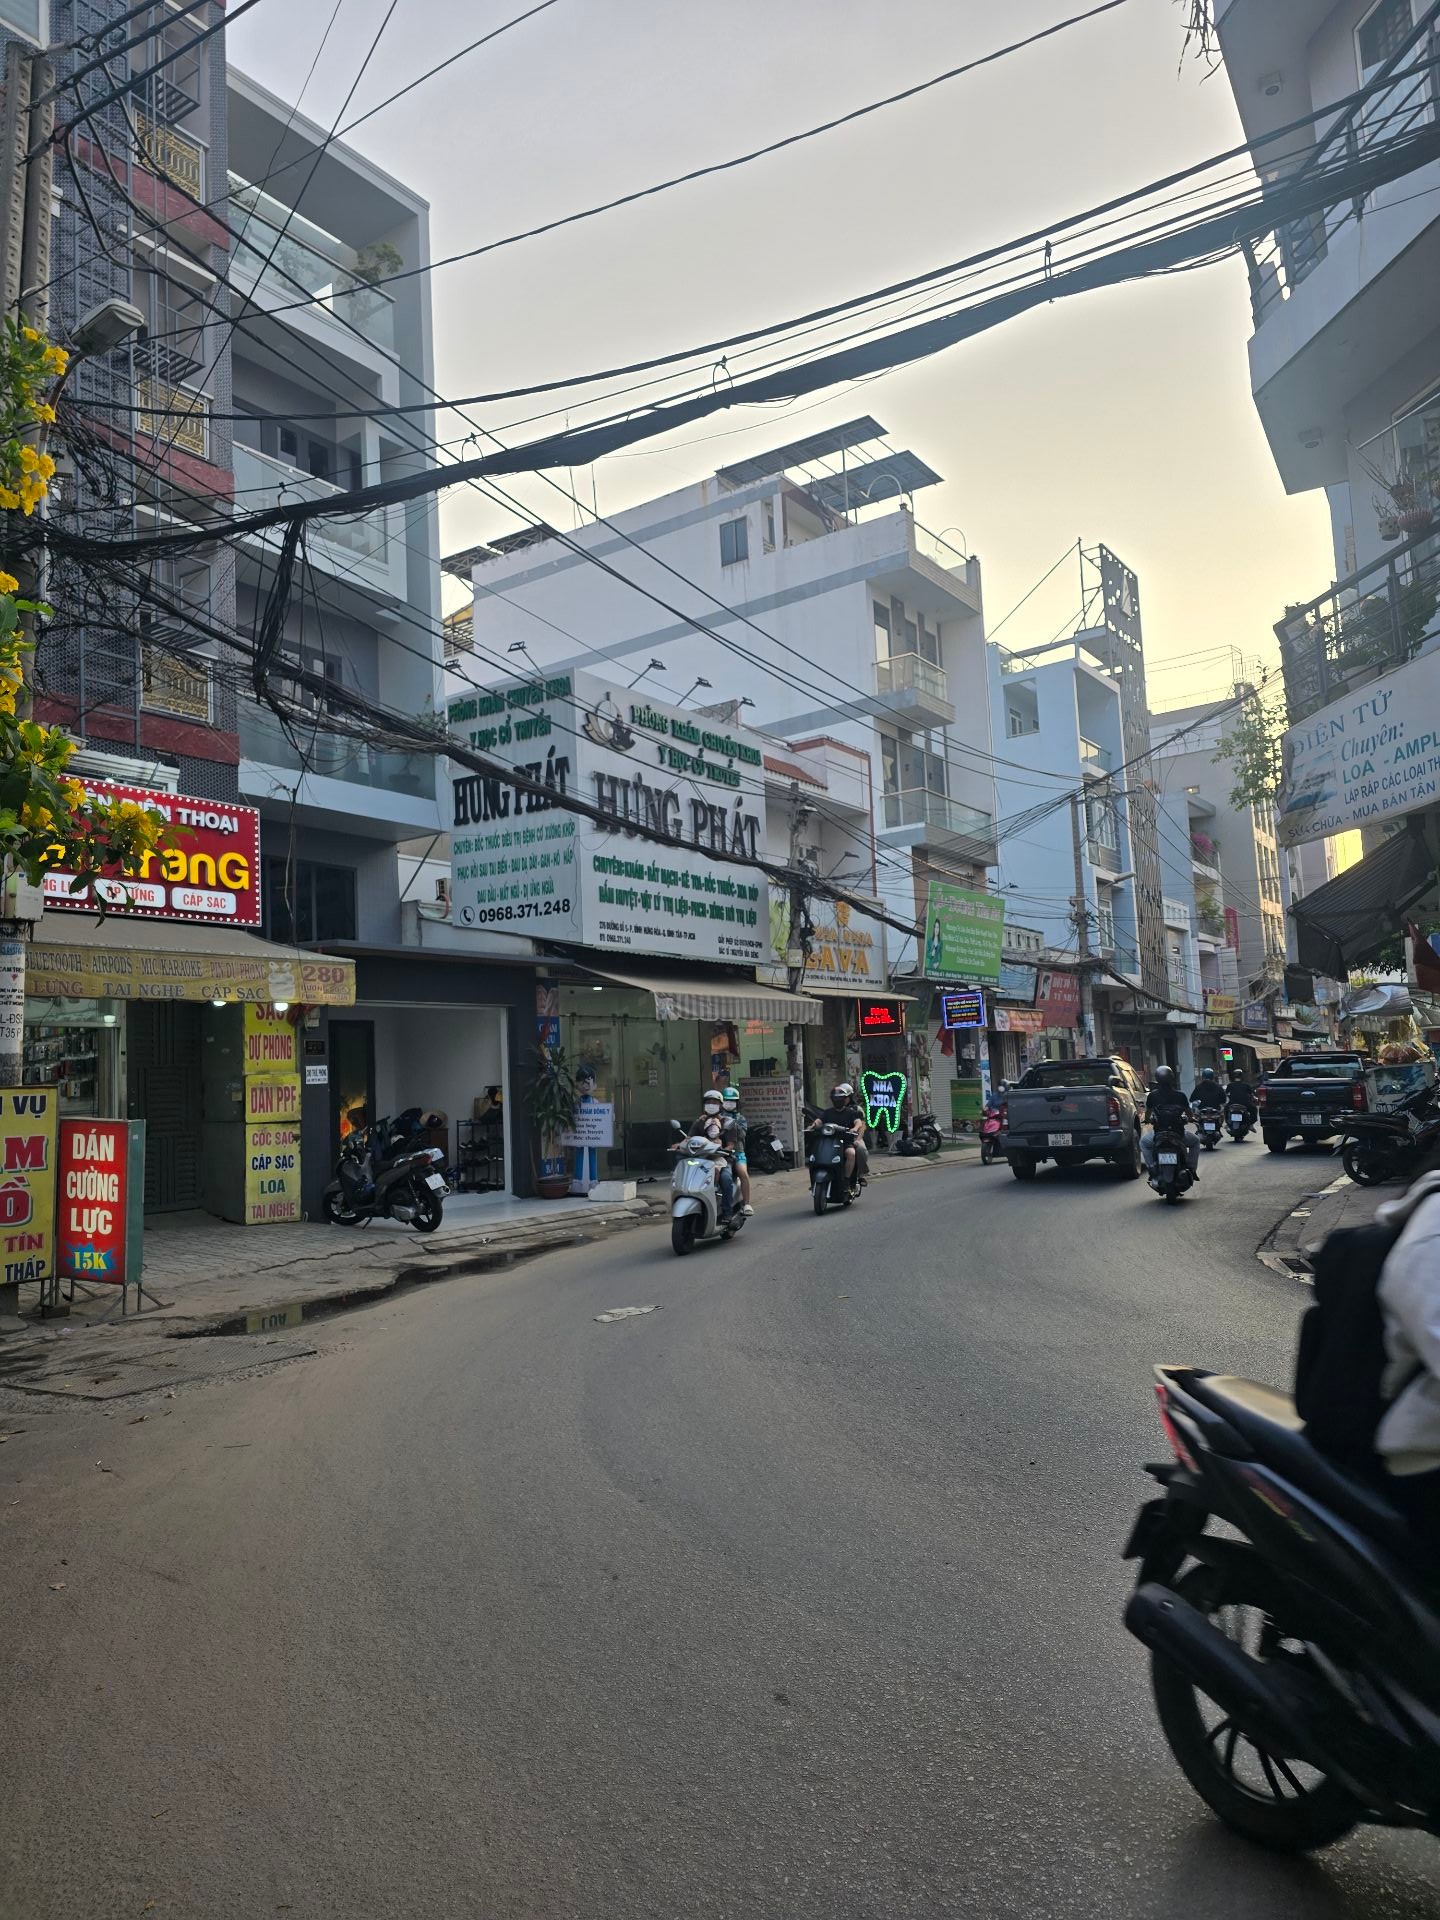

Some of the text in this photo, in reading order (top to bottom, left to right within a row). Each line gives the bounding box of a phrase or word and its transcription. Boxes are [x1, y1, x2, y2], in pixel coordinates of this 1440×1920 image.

[1353, 690, 1393, 724] TỬ
[631, 705, 762, 766] PHÒNG KHÁM CHUYÊN KHOA
[1342, 722, 1404, 762] Chuyên:
[1343, 760, 1375, 784] LOA
[1382, 771, 1400, 790] CÁC
[1403, 764, 1426, 782] LOẠI
[1312, 815, 1343, 832] CHỮA
[1353, 803, 1379, 821] MUA
[1382, 791, 1408, 810] BÁN
[1410, 781, 1436, 799] TẬN
[177, 807, 238, 835] THOẠI
[689, 796, 761, 861] PHÁT
[206, 896, 226, 911] SẠC
[479, 898, 570, 923] 0968.371.248
[93, 955, 133, 974] AIRPODS
[141, 957, 156, 976] MIC
[160, 958, 203, 978] KARAOKE
[210, 961, 224, 978] PIN
[302, 965, 345, 983] 280
[33, 978, 83, 995] LƯNG
[103, 983, 131, 996] TAI
[139, 984, 184, 997] NGHE
[249, 1033, 261, 1066] DỰ
[264, 1028, 291, 1060] PHÒNG
[251, 1082, 297, 1114] DÁN PPF
[873, 1080, 893, 1093] NHA
[13, 1095, 47, 1118] VỤ
[870, 1093, 896, 1108] KHOA
[72, 1128, 115, 1162] DÁN
[275, 1131, 294, 1148] SẠC
[252, 1153, 294, 1172] CÁP SẠC
[66, 1165, 119, 1203] CƯỜNG
[260, 1179, 285, 1194] LOA
[71, 1207, 113, 1238] LỰC
[252, 1203, 295, 1219] TAI NGHE
[5, 1232, 43, 1253] TÍN
[5, 1254, 46, 1281] THẤP
[74, 1251, 107, 1270] 15K
